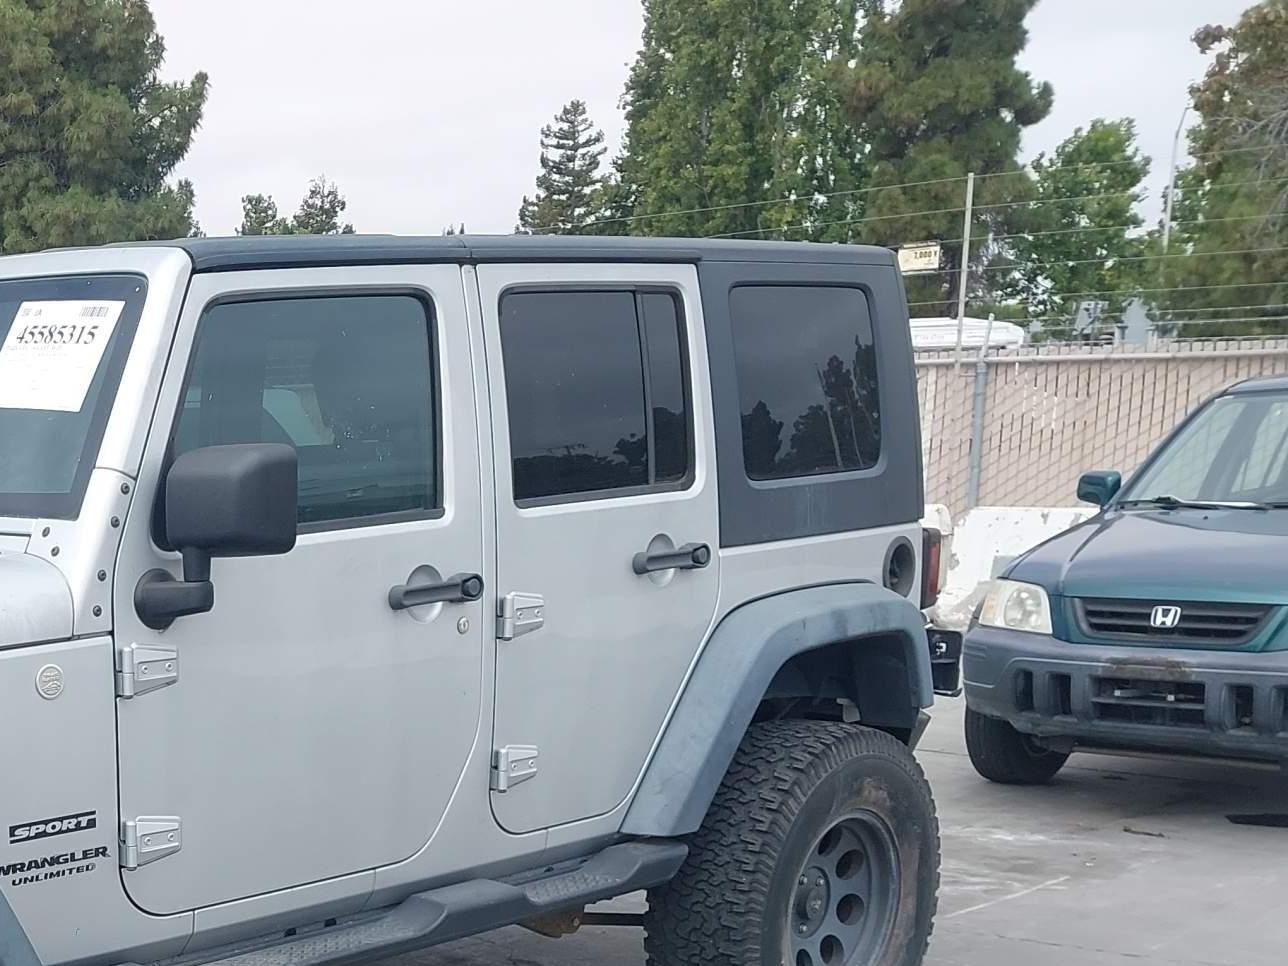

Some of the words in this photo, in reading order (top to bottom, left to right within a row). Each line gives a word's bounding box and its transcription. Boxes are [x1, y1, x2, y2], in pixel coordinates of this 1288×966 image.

[17, 325, 99, 344] 45585315
[10, 813, 96, 842] SPORT
[12, 862, 96, 887] UNLIMITED
